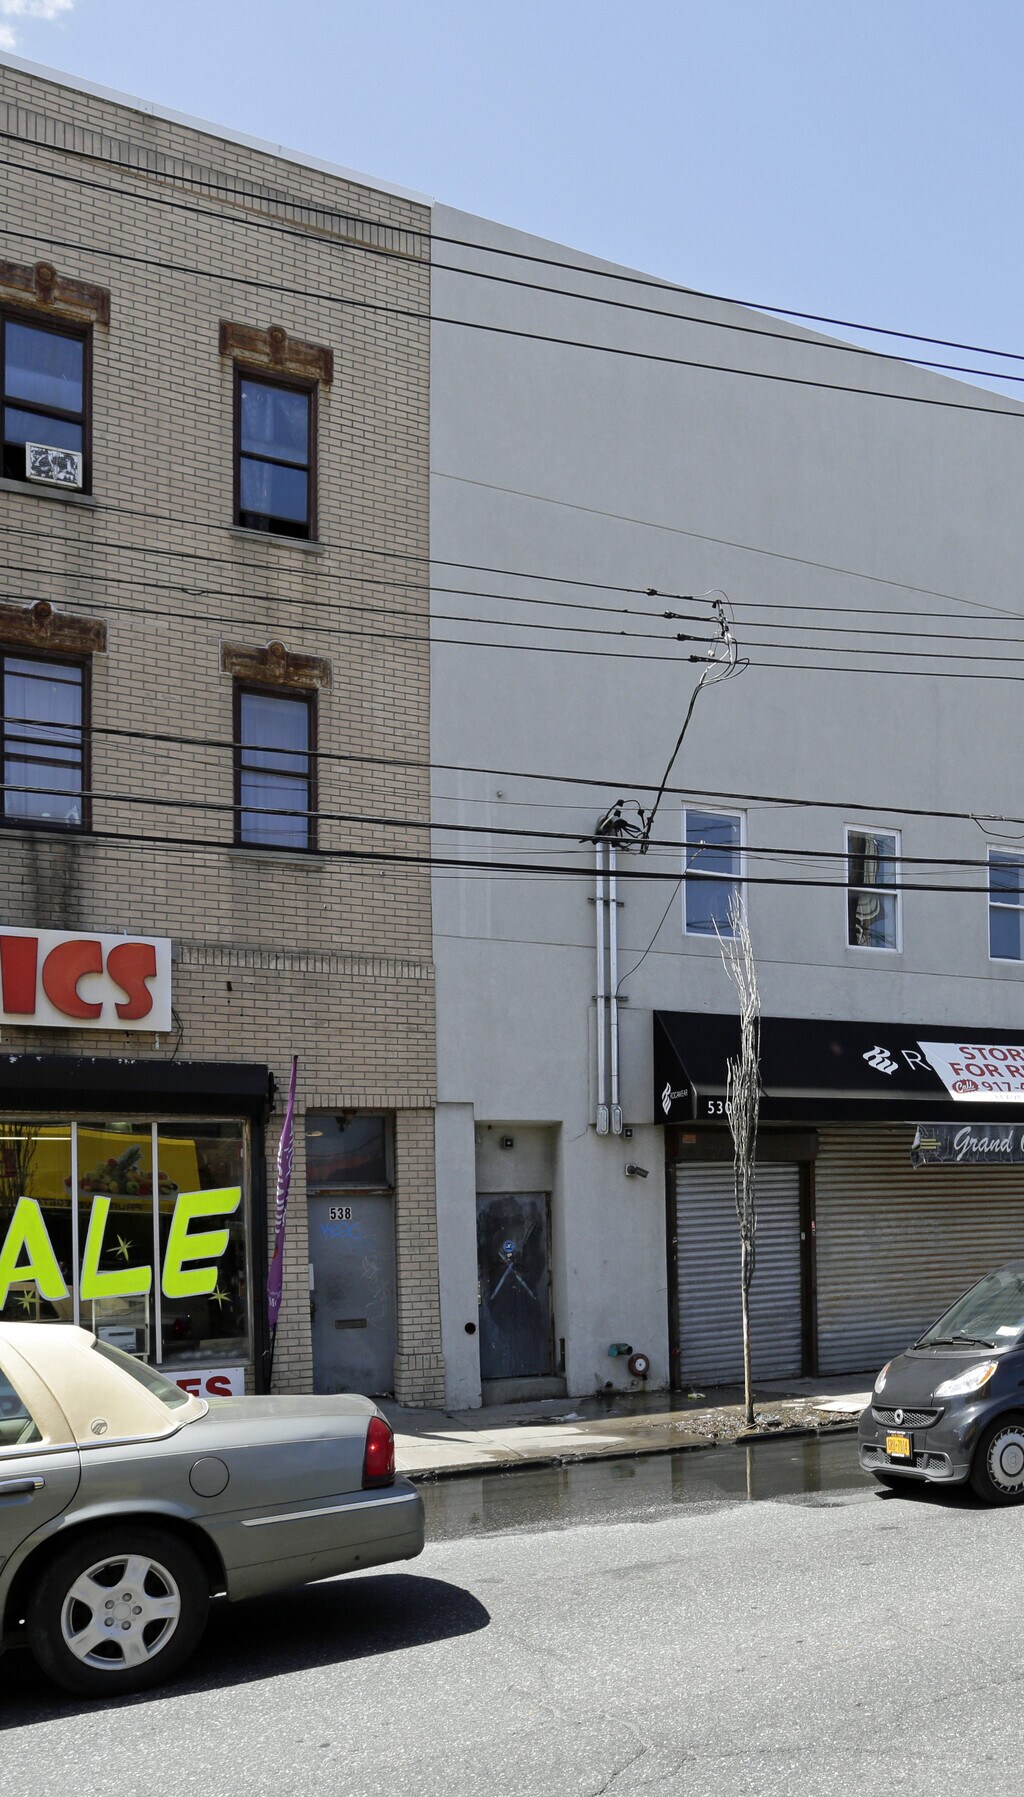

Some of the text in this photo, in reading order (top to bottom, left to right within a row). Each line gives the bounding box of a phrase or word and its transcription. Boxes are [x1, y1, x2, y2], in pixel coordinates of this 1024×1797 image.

[0, 935, 157, 1020] ICS
[949, 1062, 1002, 1077] FOR
[955, 1081, 977, 1094] Call
[707, 1101, 732, 1114] 530
[954, 1126, 1013, 1161] Grand
[330, 1207, 351, 1220] 538
[0, 1186, 242, 1310] ALE
